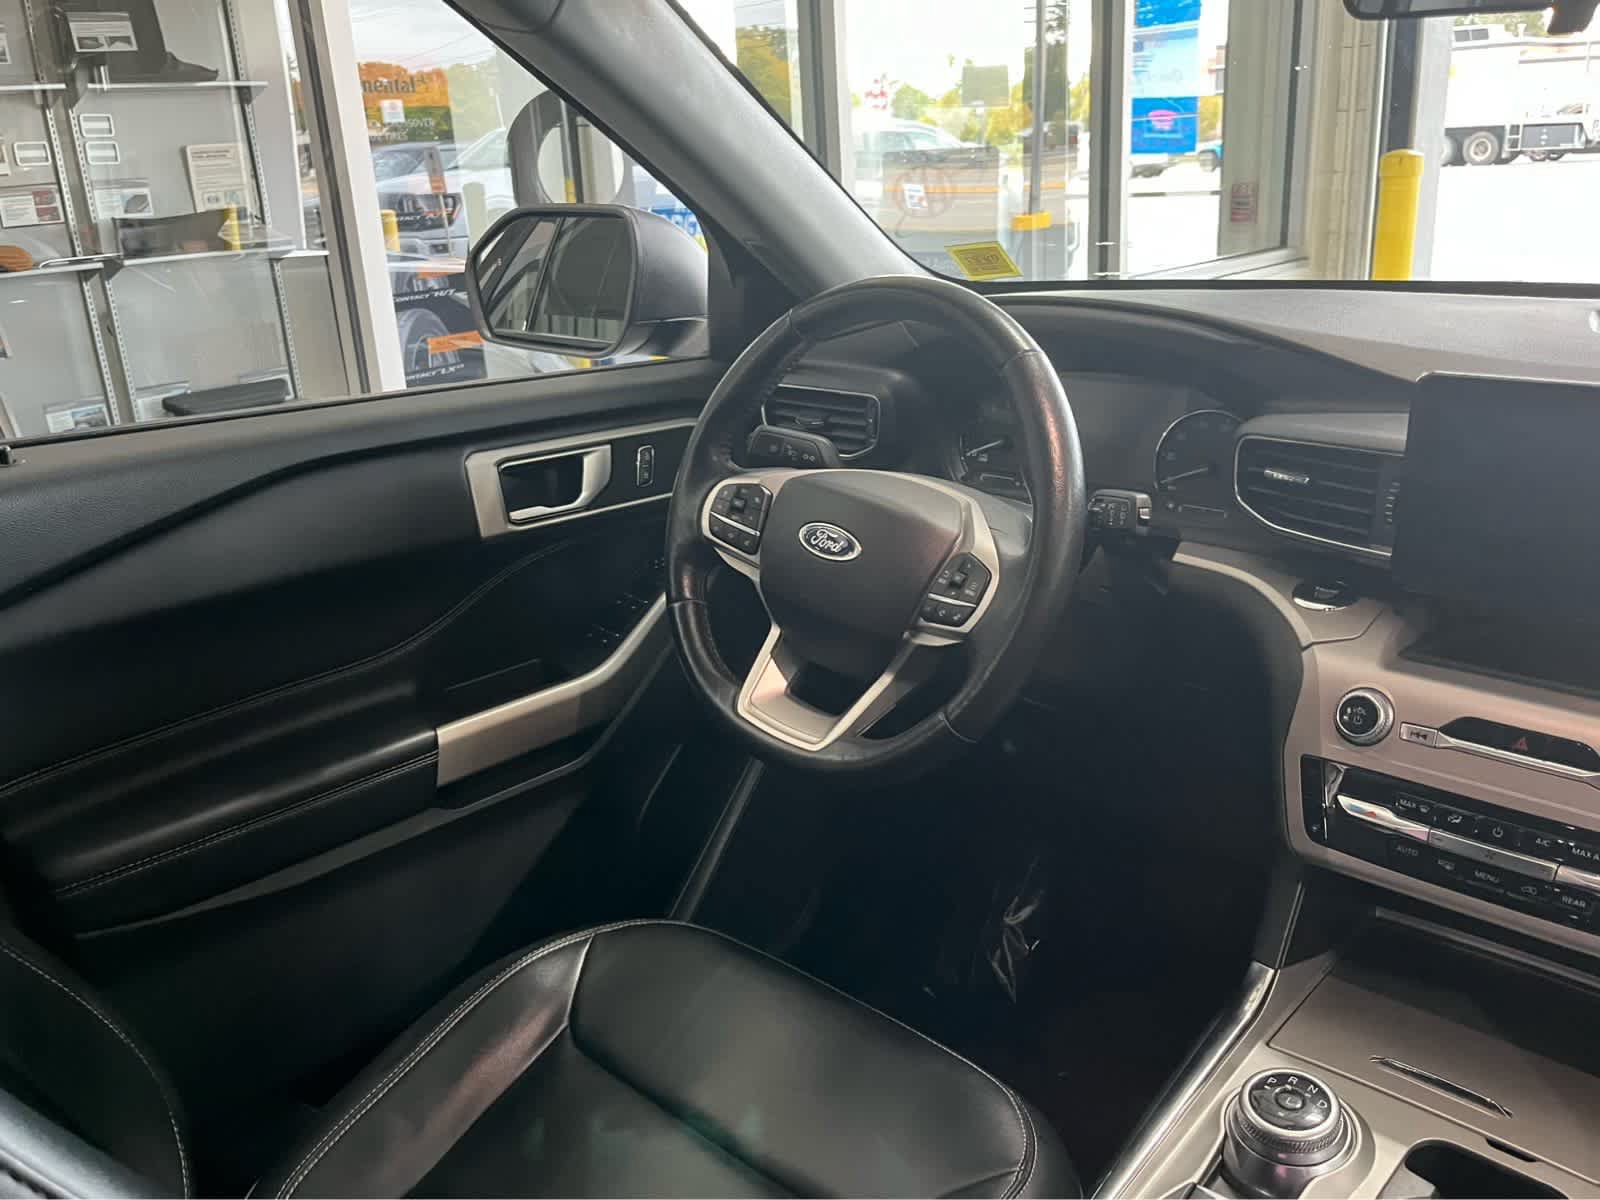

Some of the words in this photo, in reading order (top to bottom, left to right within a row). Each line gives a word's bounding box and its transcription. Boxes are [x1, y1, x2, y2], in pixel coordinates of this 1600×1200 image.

[810, 529, 845, 552] Ford
[1399, 798, 1417, 809] MAX
[1396, 844, 1419, 857] AUTO
[1571, 847, 1592, 858] MAX
[1561, 895, 1587, 908] REAR
[1267, 1076, 1277, 1085] P
[1287, 1075, 1299, 1085] R
[1306, 1084, 1319, 1094] N
